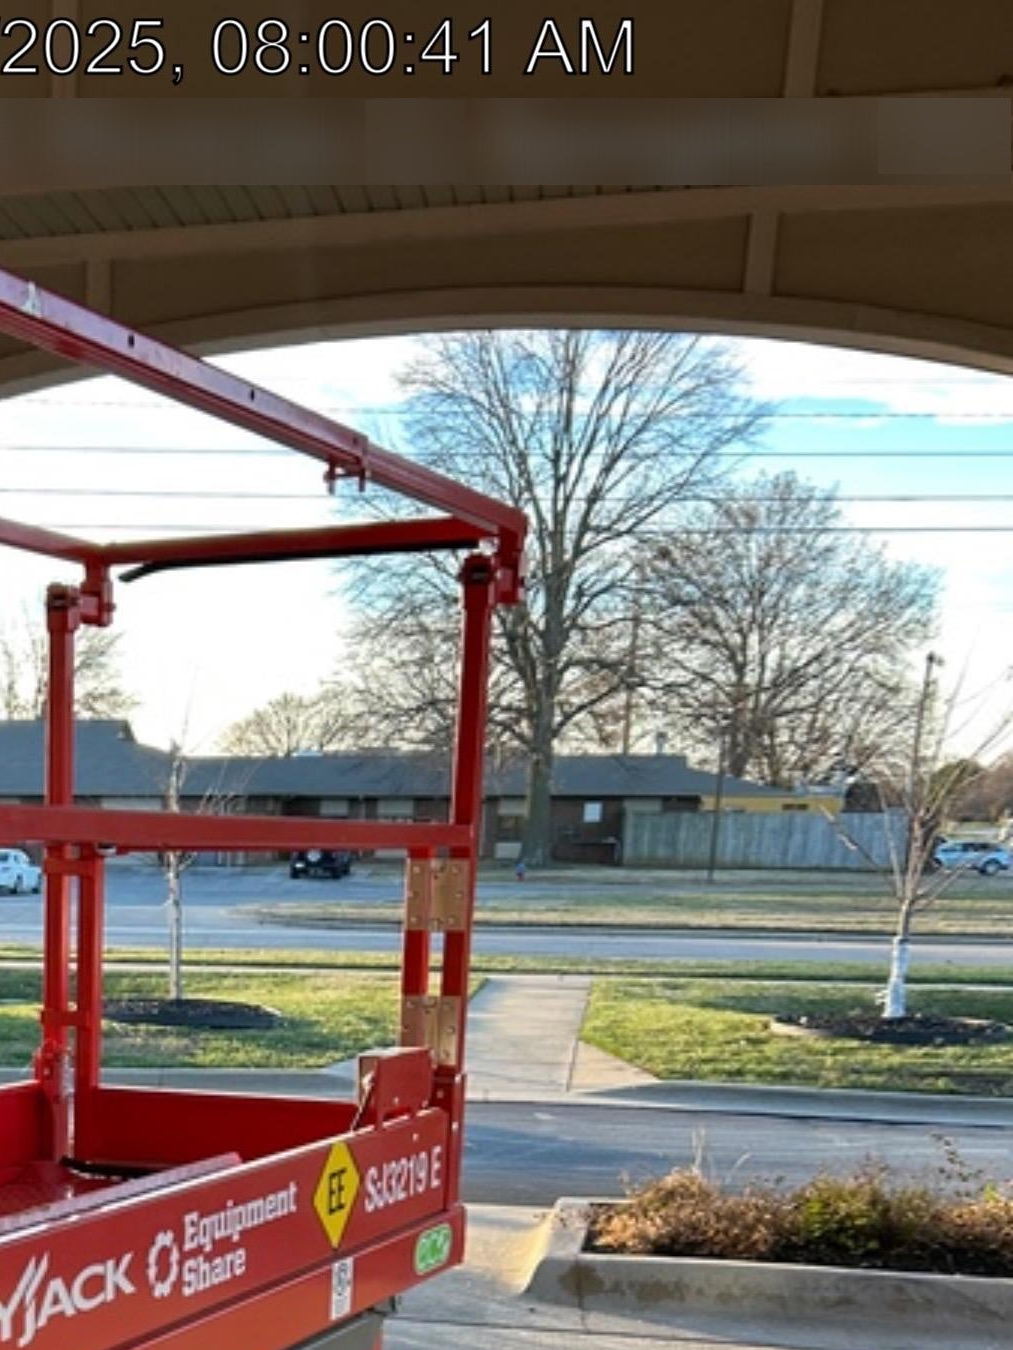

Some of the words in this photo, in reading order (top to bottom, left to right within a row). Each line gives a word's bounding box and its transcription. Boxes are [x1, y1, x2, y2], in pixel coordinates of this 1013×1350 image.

[183, 1180, 297, 1251] Equipment
[328, 1168, 347, 1215] EE
[182, 1248, 247, 1297] Share
